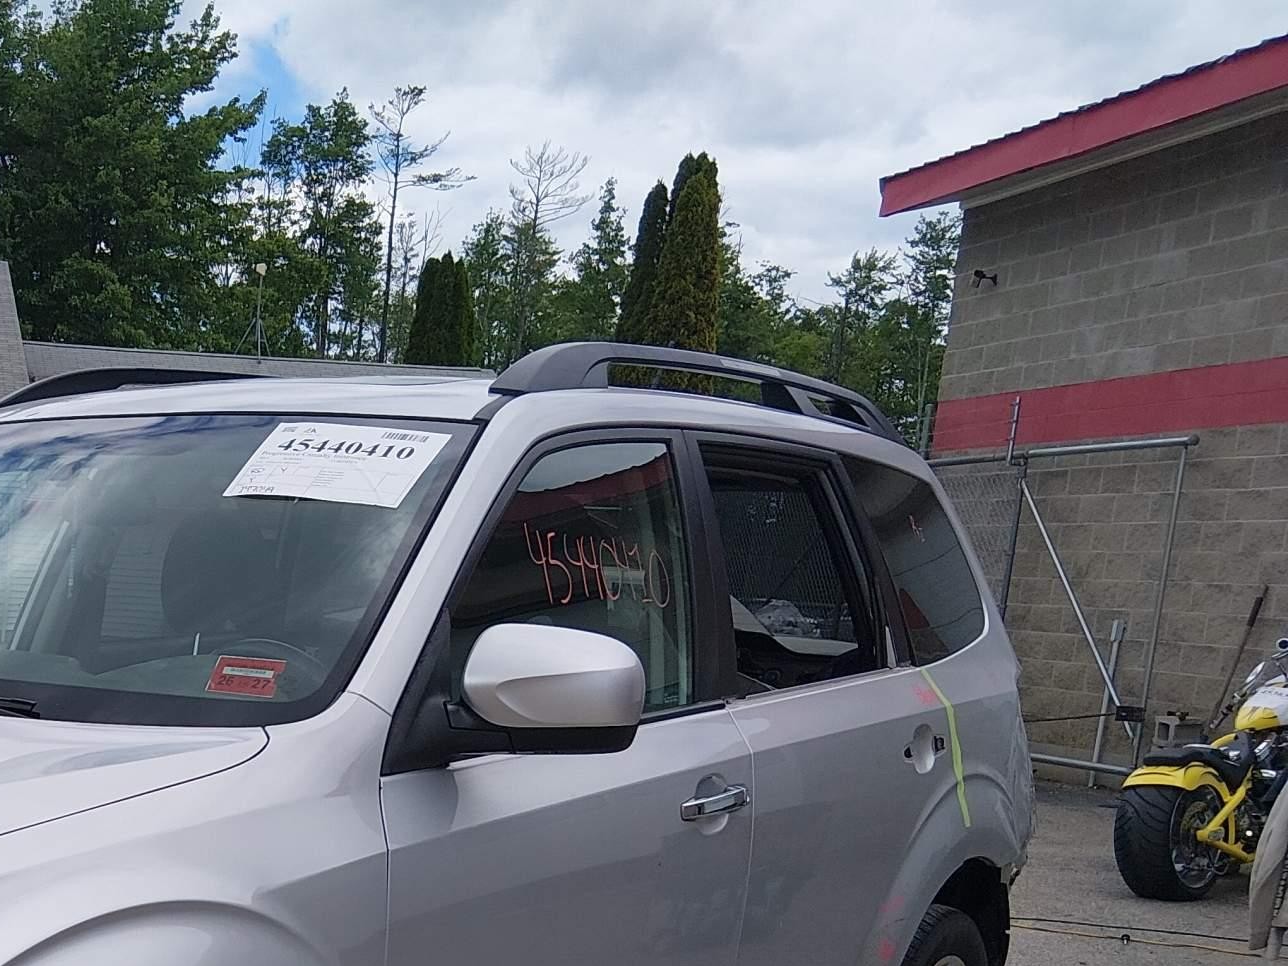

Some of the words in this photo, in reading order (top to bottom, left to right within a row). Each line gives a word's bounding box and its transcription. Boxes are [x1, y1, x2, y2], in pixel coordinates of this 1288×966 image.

[277, 437, 415, 460] 45440410
[523, 522, 670, 608] 45440410
[252, 678, 271, 689] 27
